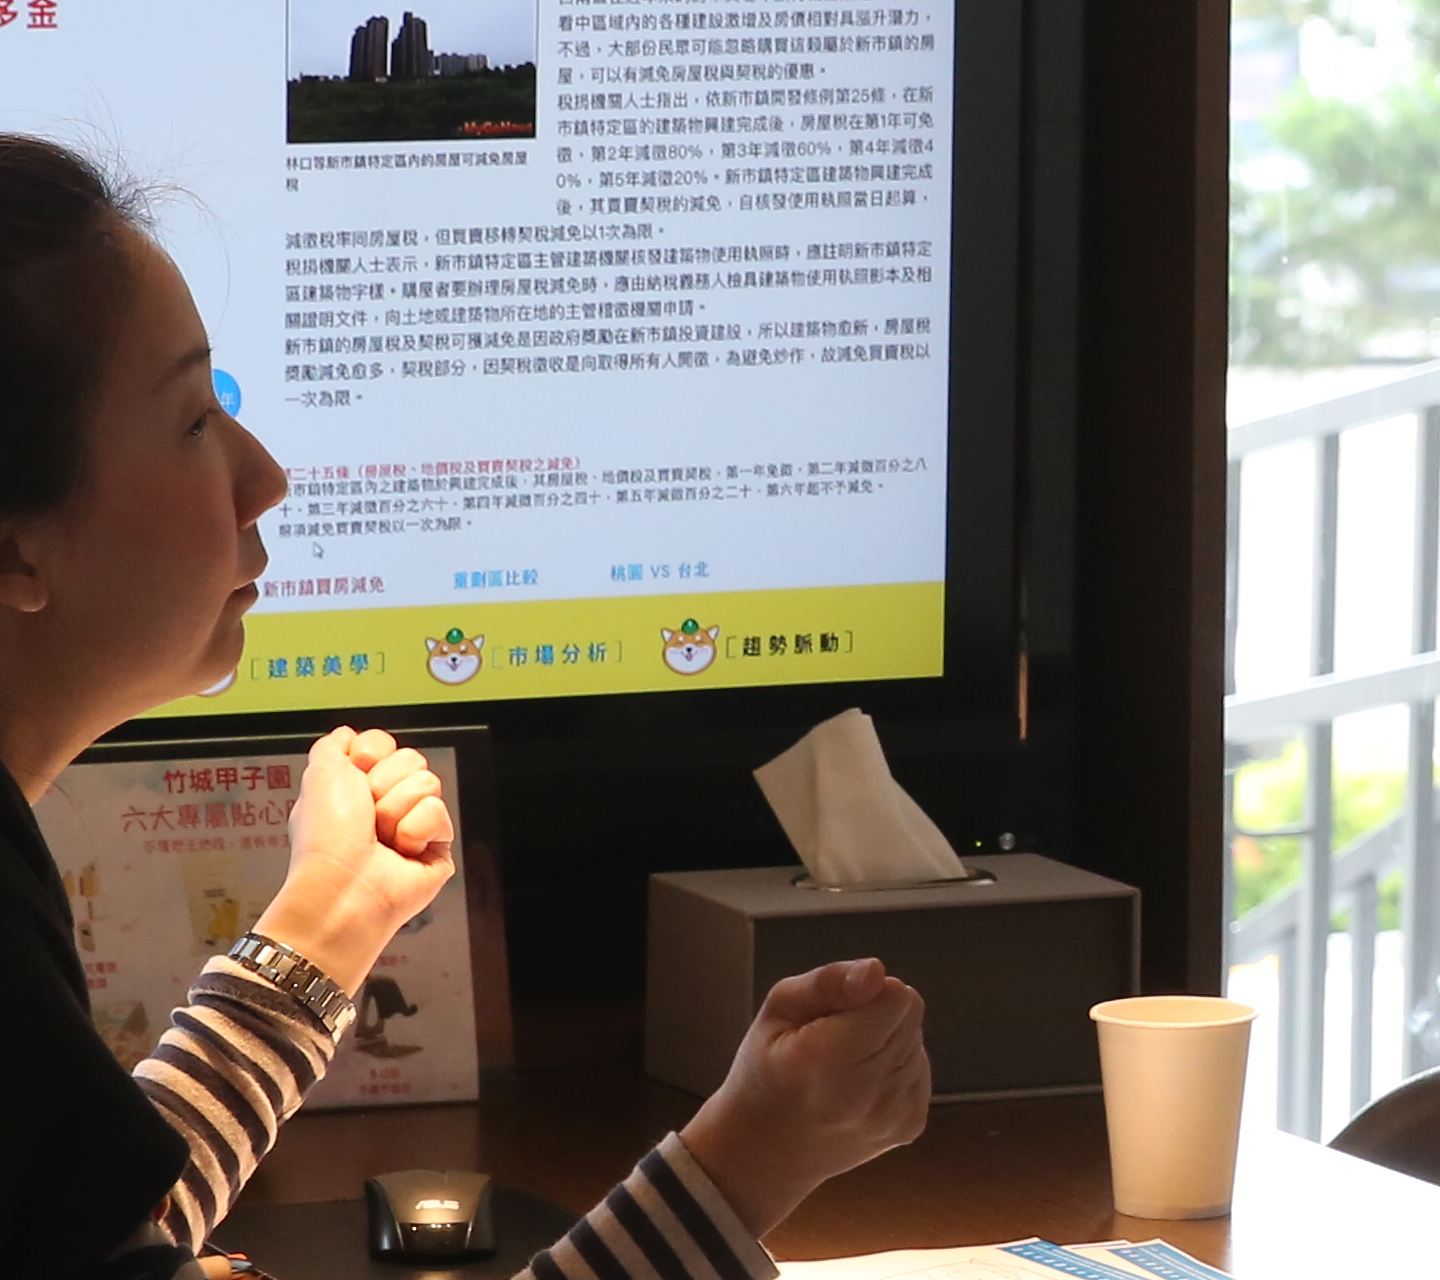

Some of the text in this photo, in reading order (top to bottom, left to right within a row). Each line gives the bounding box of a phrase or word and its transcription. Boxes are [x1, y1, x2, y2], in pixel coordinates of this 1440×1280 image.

[611, 560, 710, 582] 桃園 VS 台北
[164, 765, 291, 794] 竹城甲子園
[122, 800, 296, 832] 六大專屬貼心
